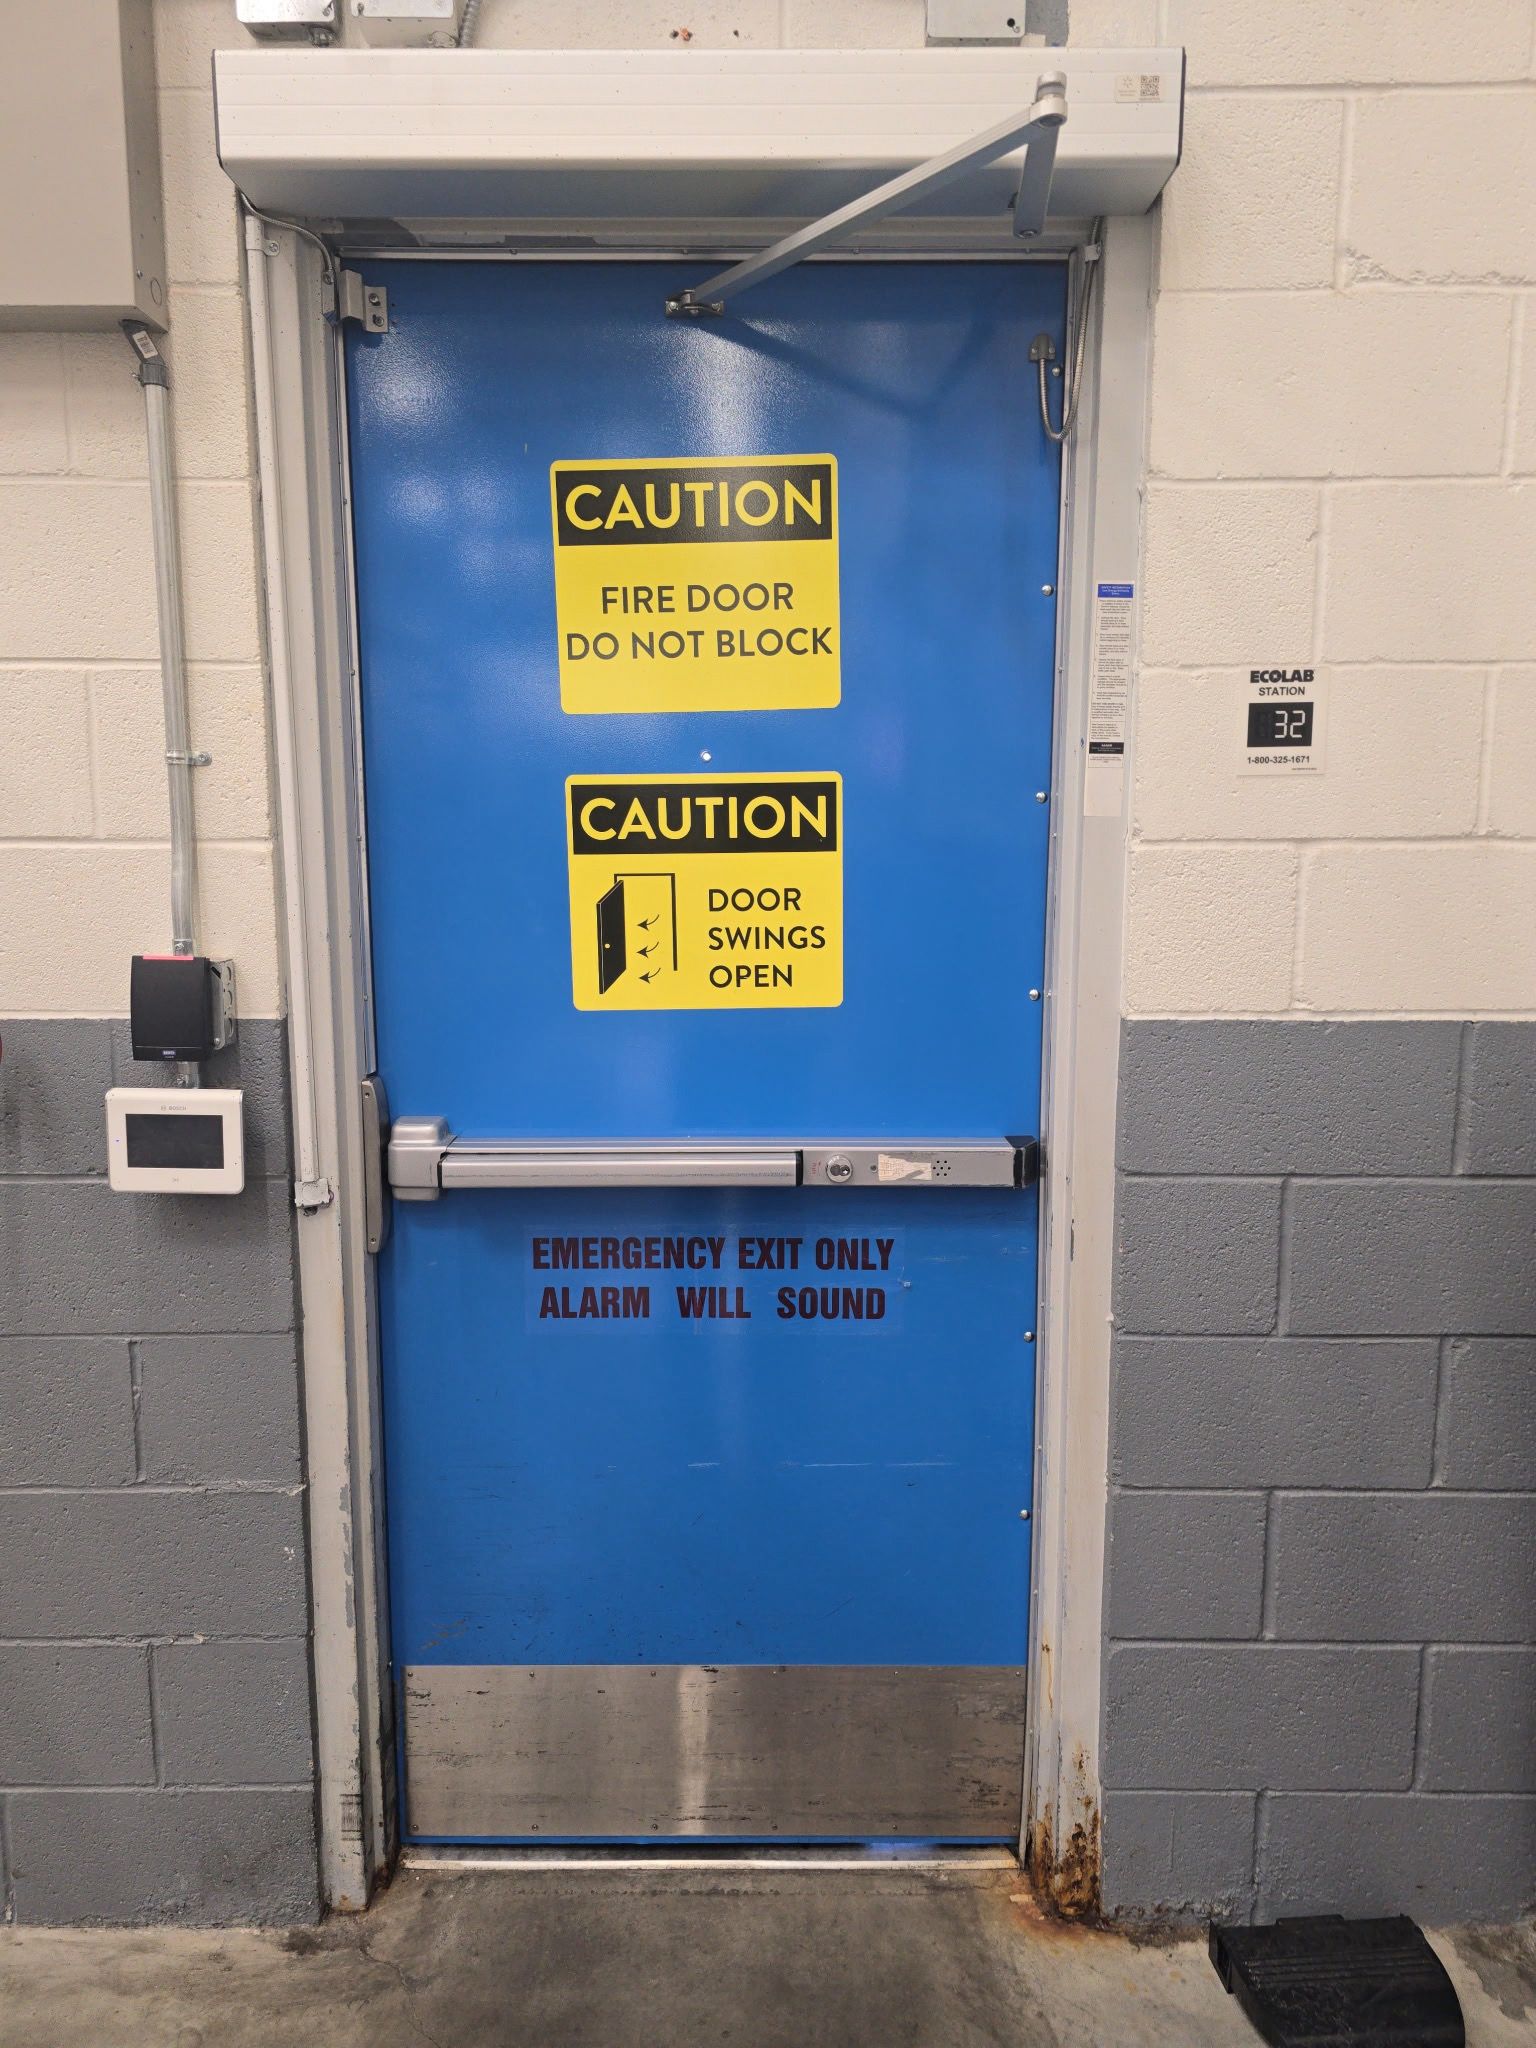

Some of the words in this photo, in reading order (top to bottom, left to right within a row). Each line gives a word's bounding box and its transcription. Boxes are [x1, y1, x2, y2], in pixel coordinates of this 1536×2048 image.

[565, 479, 824, 531] CAUTION
[601, 585, 676, 614] FIRE
[687, 582, 794, 613] DOOR
[567, 631, 620, 661] DO
[632, 630, 705, 660] NOT
[716, 626, 833, 658] BLOCK
[1250, 669, 1315, 684] ECOLAB
[1258, 686, 1306, 696] STATION
[1274, 710, 1306, 739] 32
[1247, 755, 1310, 765] 1-800-325-1671
[580, 795, 828, 841] CAUTION
[708, 887, 802, 913] DOOR
[708, 925, 826, 951] SWINGS
[709, 964, 793, 989] OPEN
[532, 1236, 725, 1270] EMERGENCY
[738, 1237, 803, 1270] EXIT
[815, 1237, 895, 1271] ONLY
[539, 1286, 650, 1319] ALARM
[676, 1286, 752, 1319] WILL
[776, 1286, 885, 1320] SOUND
